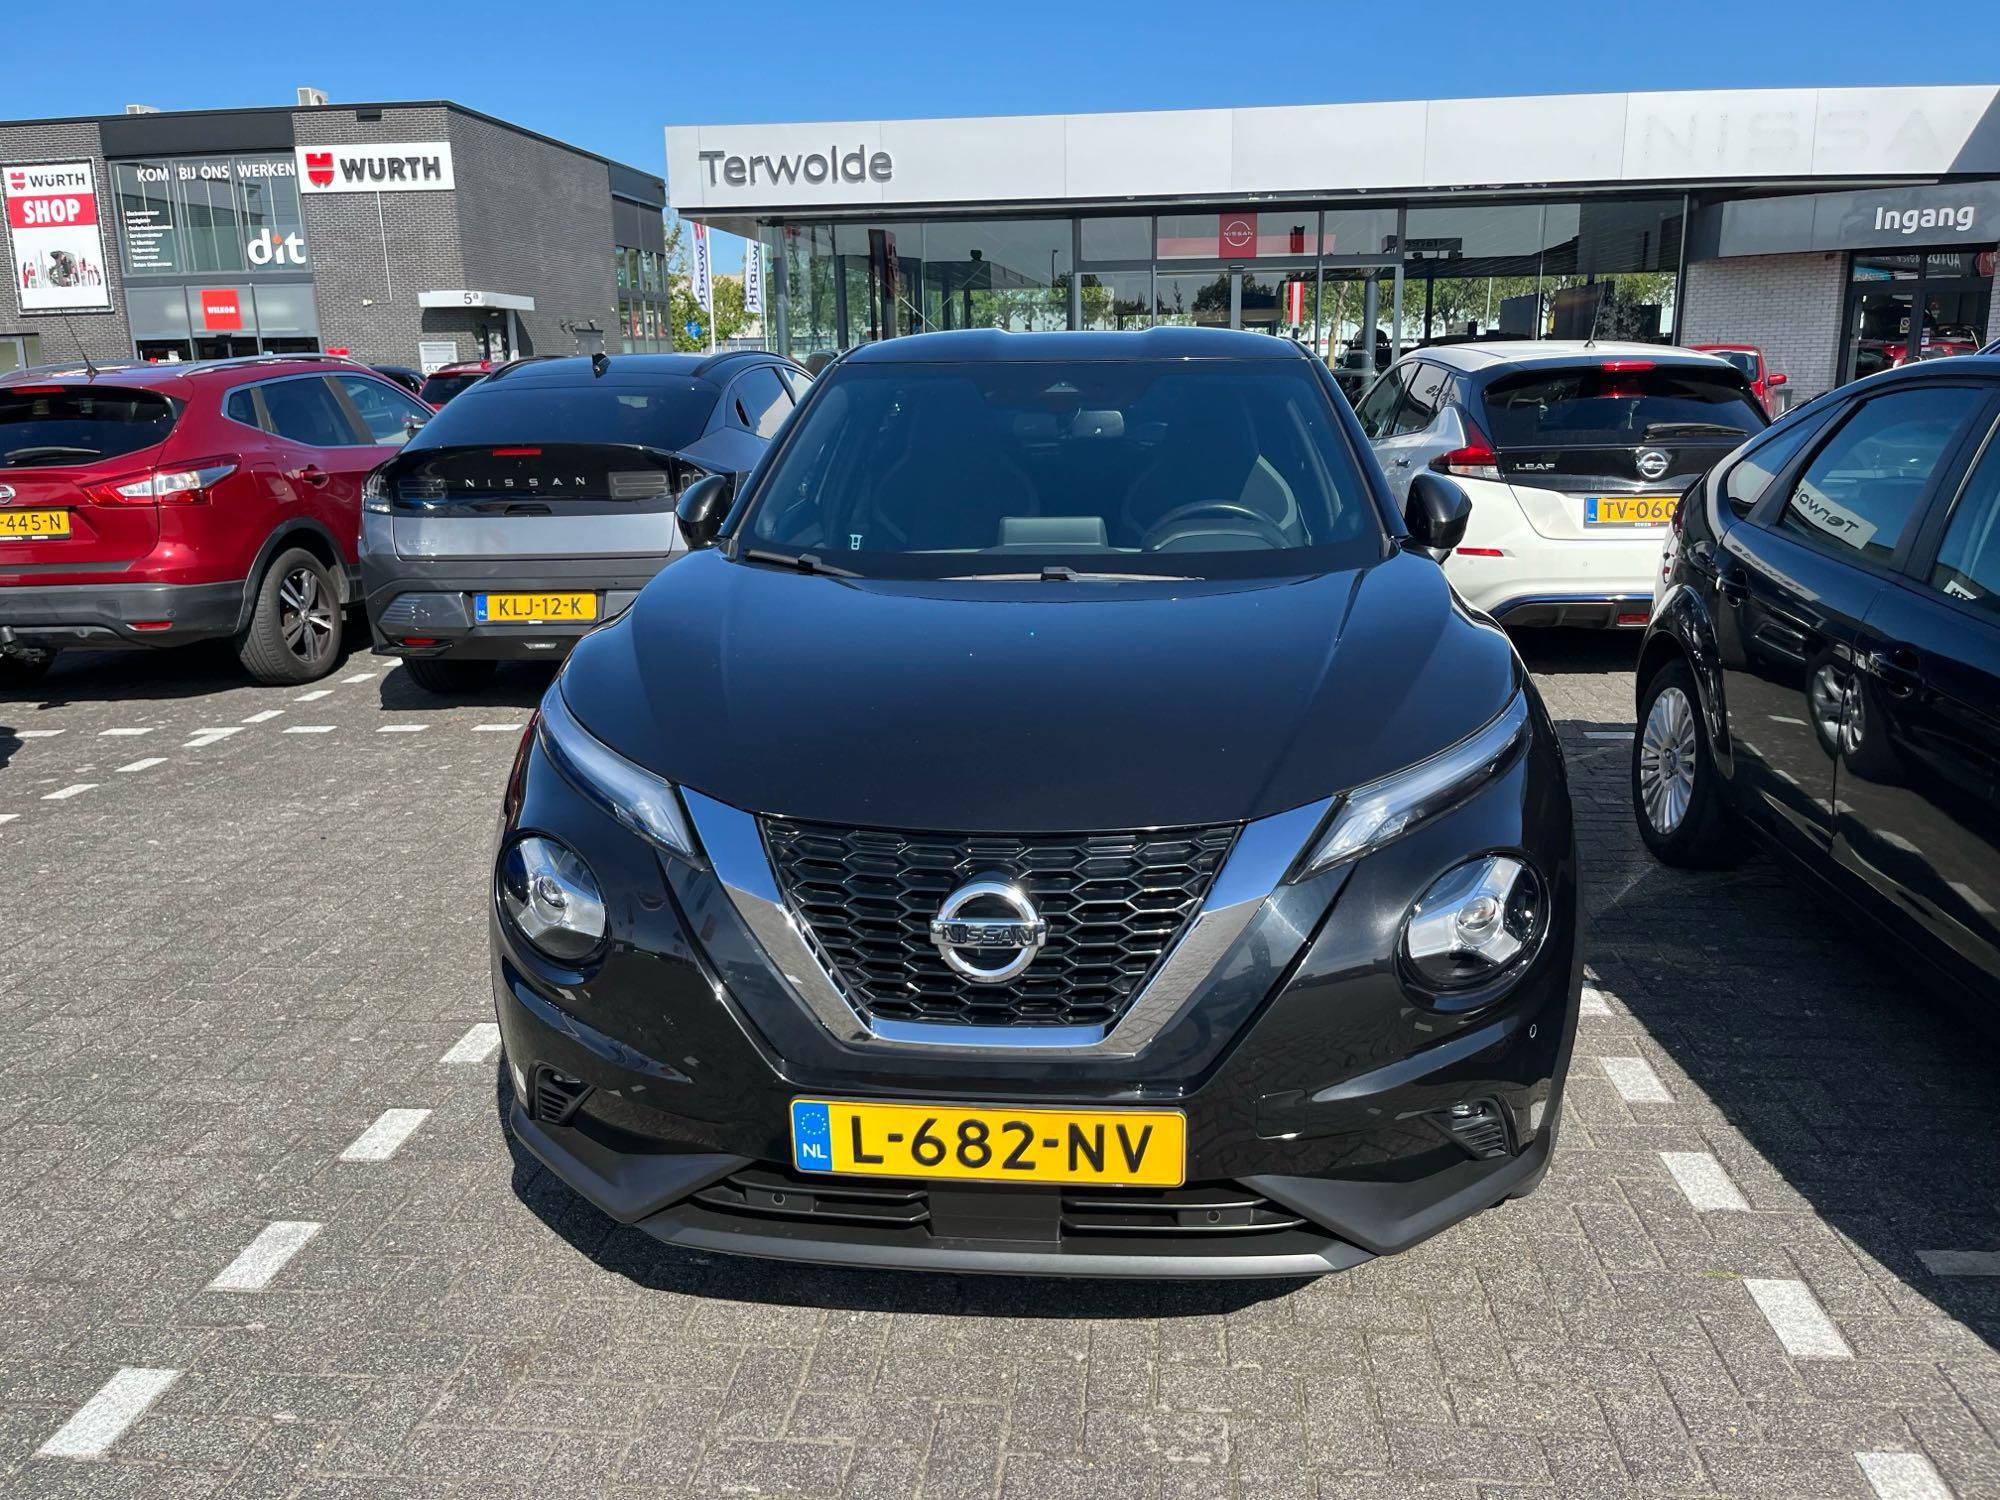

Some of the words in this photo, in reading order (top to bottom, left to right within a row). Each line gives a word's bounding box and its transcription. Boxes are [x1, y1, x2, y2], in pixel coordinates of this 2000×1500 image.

[137, 167, 170, 182] KOM
[178, 166, 197, 181] BIJ
[200, 165, 230, 180] ONS
[237, 163, 296, 178] WERKEN
[339, 156, 442, 183] WÜRTH
[698, 144, 893, 187] Terwolde
[29, 173, 86, 188] WÜRTH
[23, 198, 81, 225] SHOP
[1874, 206, 1975, 234] Ingang
[247, 228, 307, 265] dit
[1514, 463, 1556, 471] LEAF
[464, 476, 586, 488] NISSAN
[498, 597, 583, 616] KLJ-12-K
[942, 925, 1038, 946] NISSAN
[802, 1142, 828, 1160] NL
[850, 1115, 1154, 1174] L-682-NV
